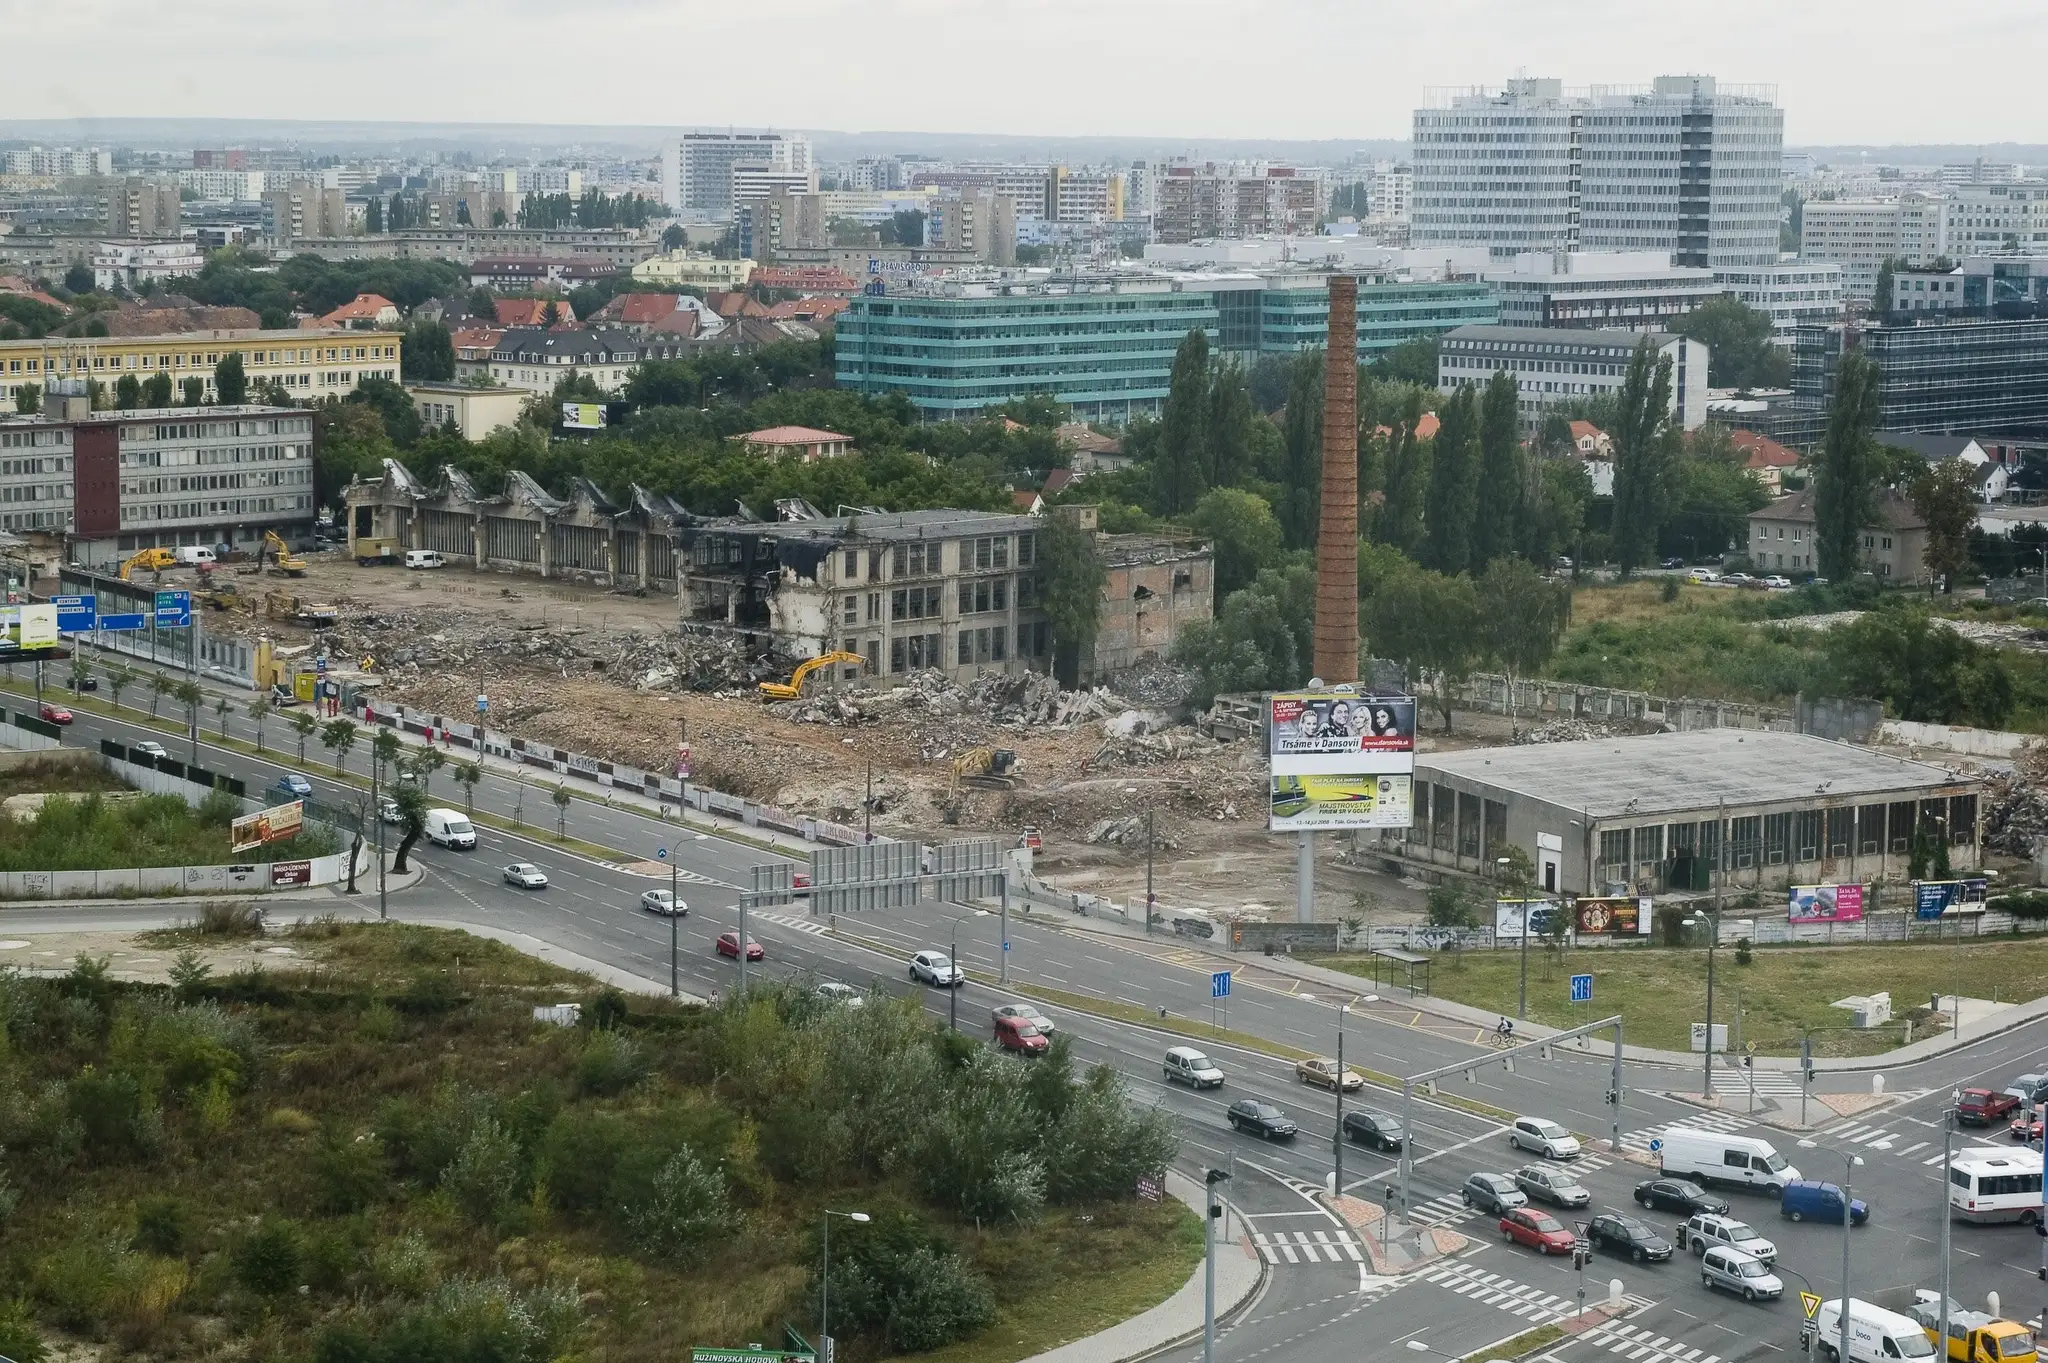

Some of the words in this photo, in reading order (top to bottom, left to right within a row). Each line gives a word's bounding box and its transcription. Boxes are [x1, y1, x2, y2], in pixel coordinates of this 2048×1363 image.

[881, 261, 905, 271] REAVIS
[906, 262, 932, 271] GROUP
[1282, 739, 1312, 749] Trsáme
[1322, 738, 1359, 748] Dansovii
[1855, 1329, 1872, 1342] boco
